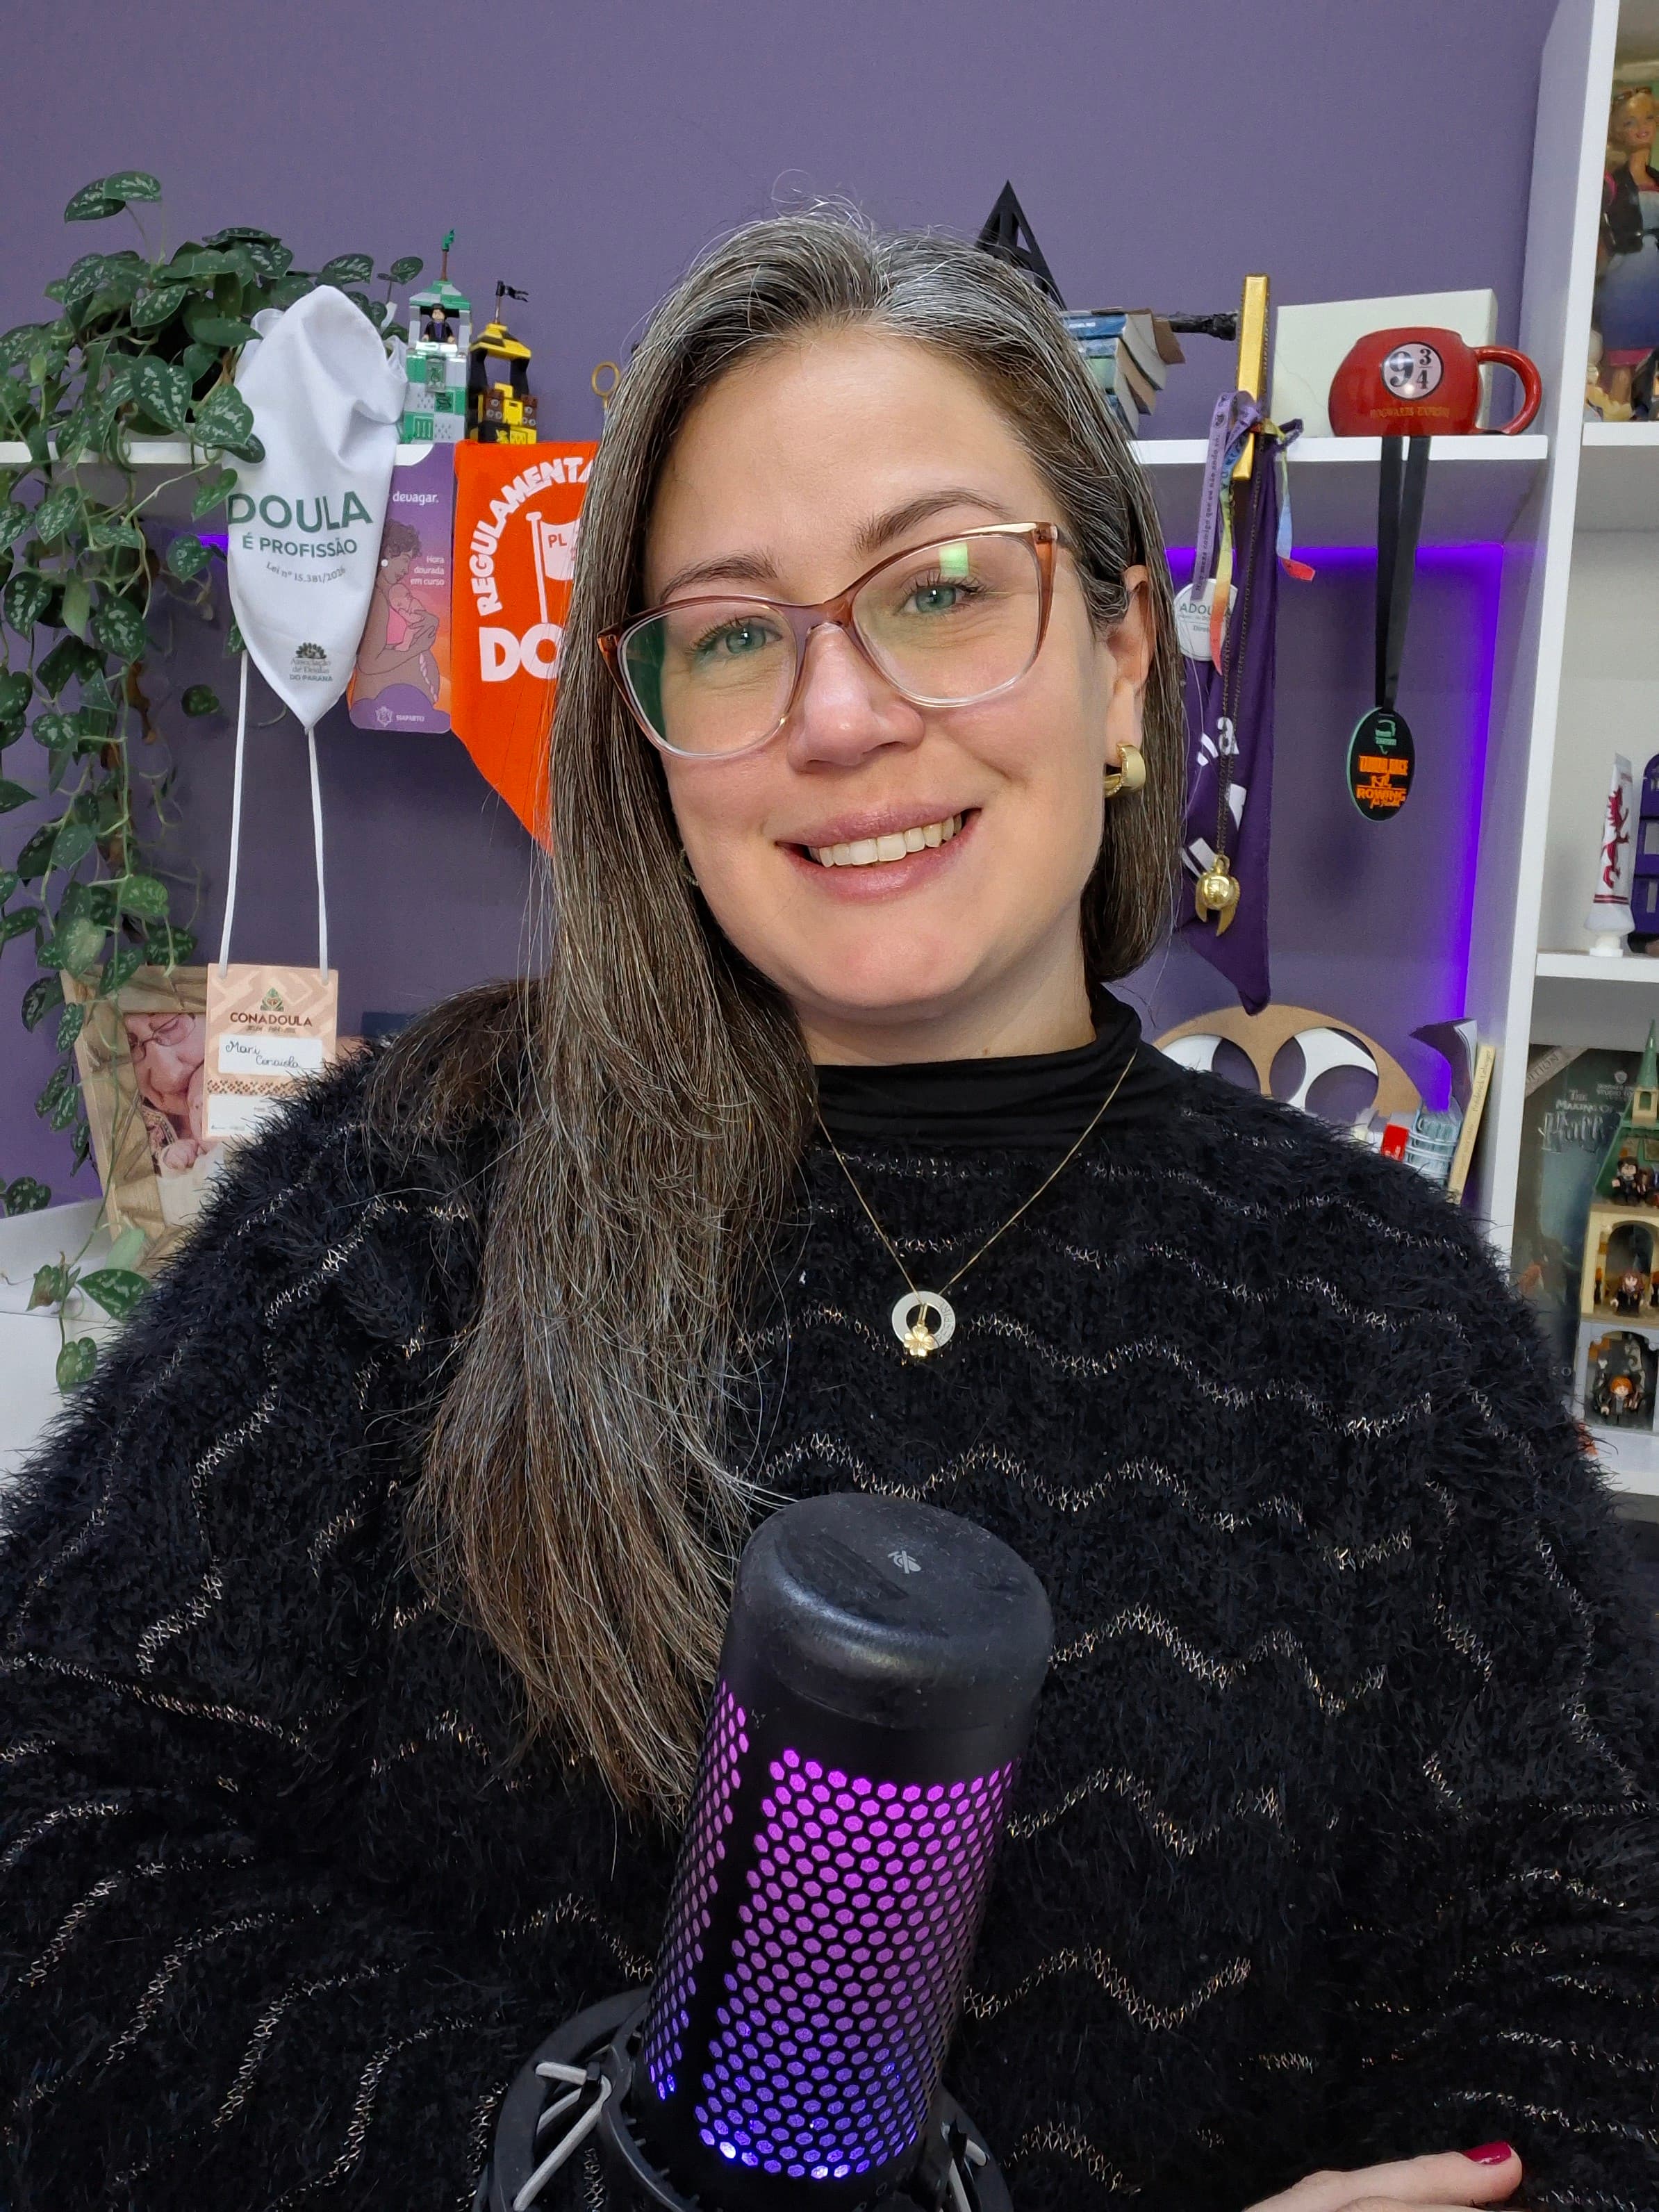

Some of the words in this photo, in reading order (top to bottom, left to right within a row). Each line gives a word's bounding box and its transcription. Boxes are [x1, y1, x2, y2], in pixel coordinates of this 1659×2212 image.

[1390, 351, 1414, 388] 9
[393, 491, 439, 506] devagar.
[228, 491, 373, 533] DOULA
[242, 532, 254, 550] É
[259, 538, 358, 559] PROFISSÃO
[547, 533, 568, 548] PL
[427, 556, 445, 564] Hora
[266, 561, 279, 575] Lei
[414, 566, 445, 575] dourada
[230, 1012, 313, 1027] CONADOULA
[225, 1041, 261, 1055] Mari
